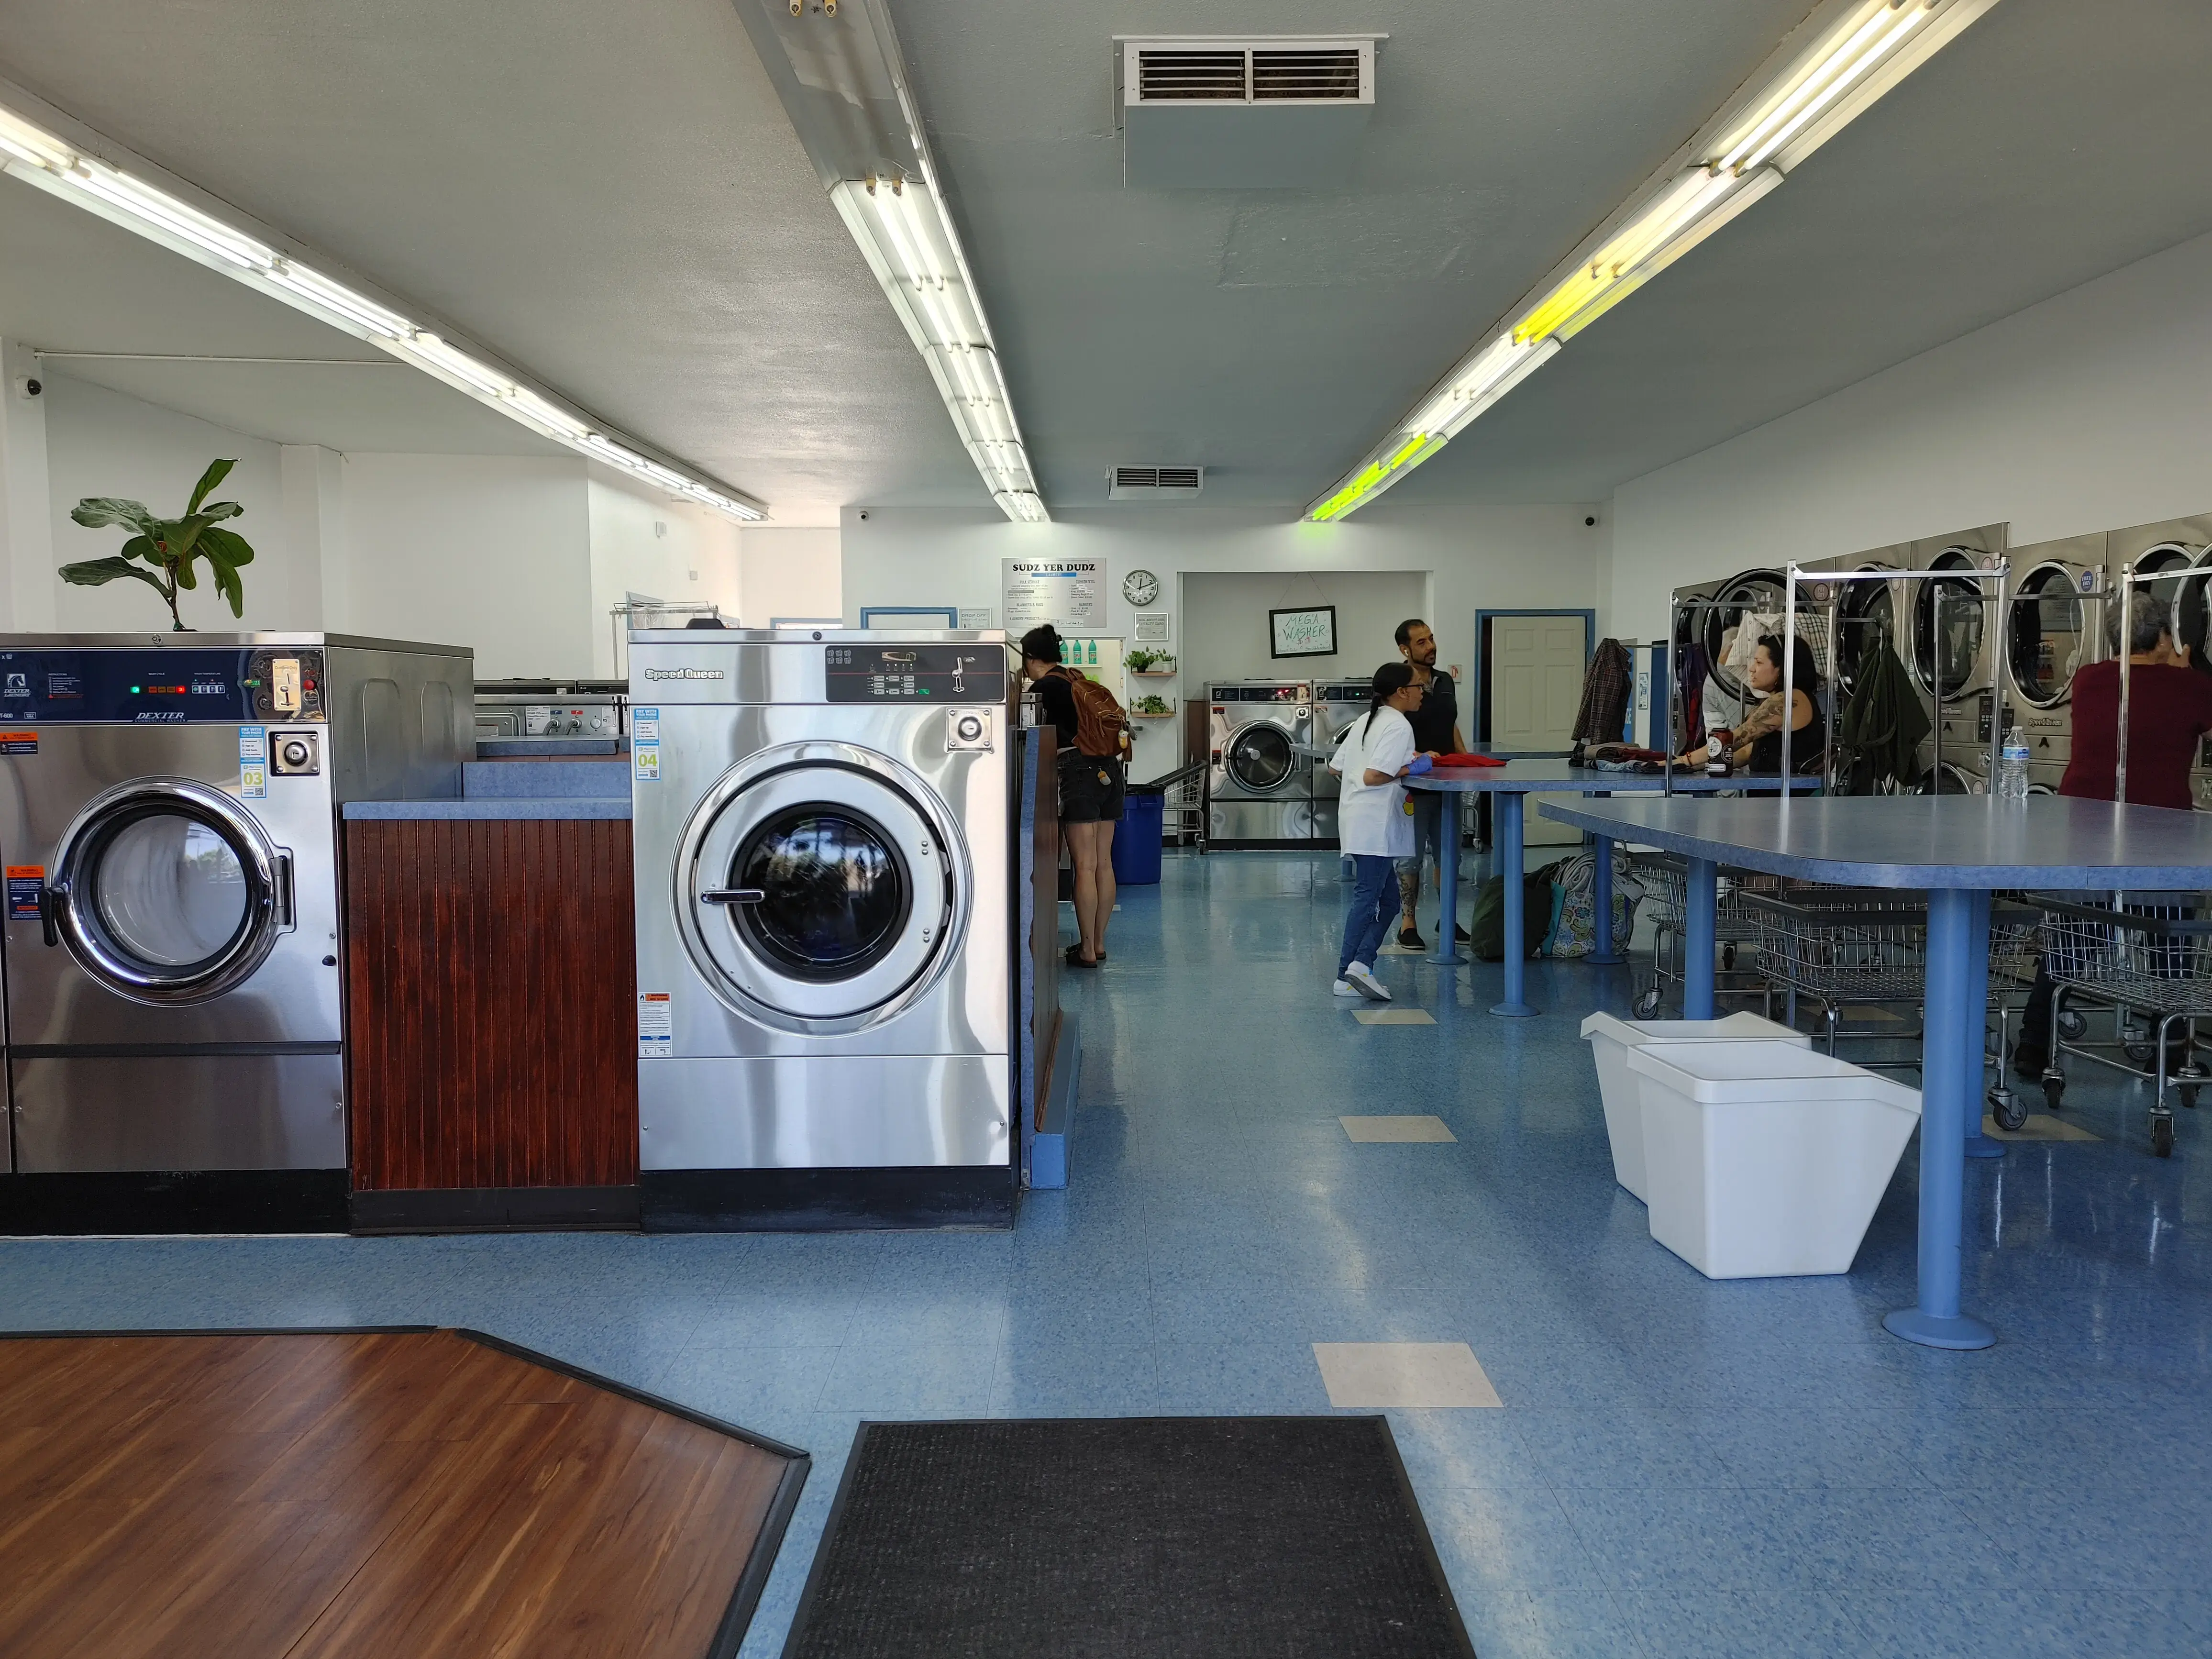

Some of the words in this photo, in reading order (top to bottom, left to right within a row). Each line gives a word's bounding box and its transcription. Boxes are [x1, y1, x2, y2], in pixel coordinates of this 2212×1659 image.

[1285, 614, 1320, 627] MEGA
[1283, 625, 1326, 640] WASHER
[645, 668, 685, 681] Speed
[685, 668, 724, 679] Queen
[638, 754, 657, 767] 04
[243, 772, 263, 785] 03
